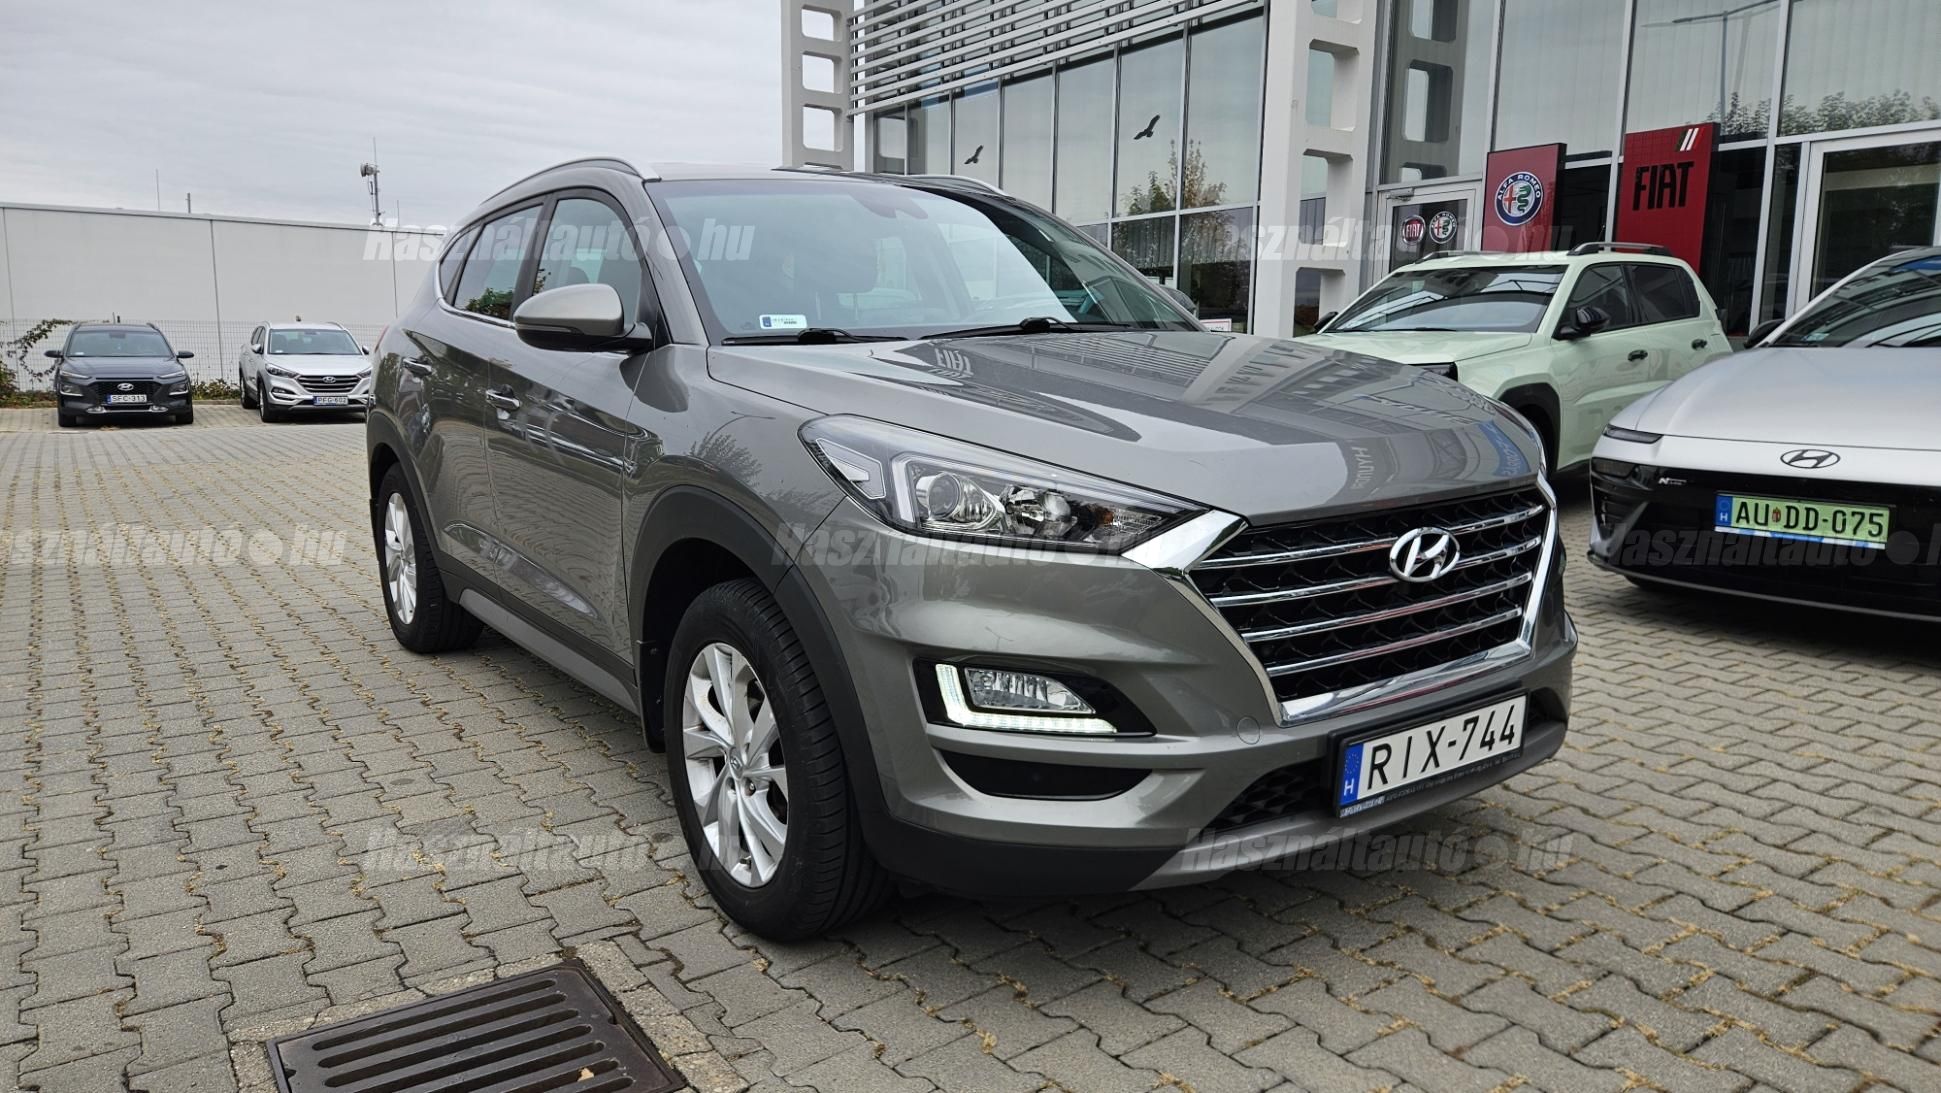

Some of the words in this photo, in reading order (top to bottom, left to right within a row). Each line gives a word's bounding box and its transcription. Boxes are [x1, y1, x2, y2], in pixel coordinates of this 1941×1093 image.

[1497, 178, 1513, 200] ALFA
[1517, 174, 1541, 198] ROMEO
[1632, 161, 1694, 211] FIAT
[1406, 223, 1421, 238] FIAT
[1720, 513, 1728, 521] H
[1735, 501, 1769, 526] AU
[1783, 504, 1884, 537] DD-075
[1367, 704, 1515, 790] RIX-744
[1343, 778, 1355, 796] H
